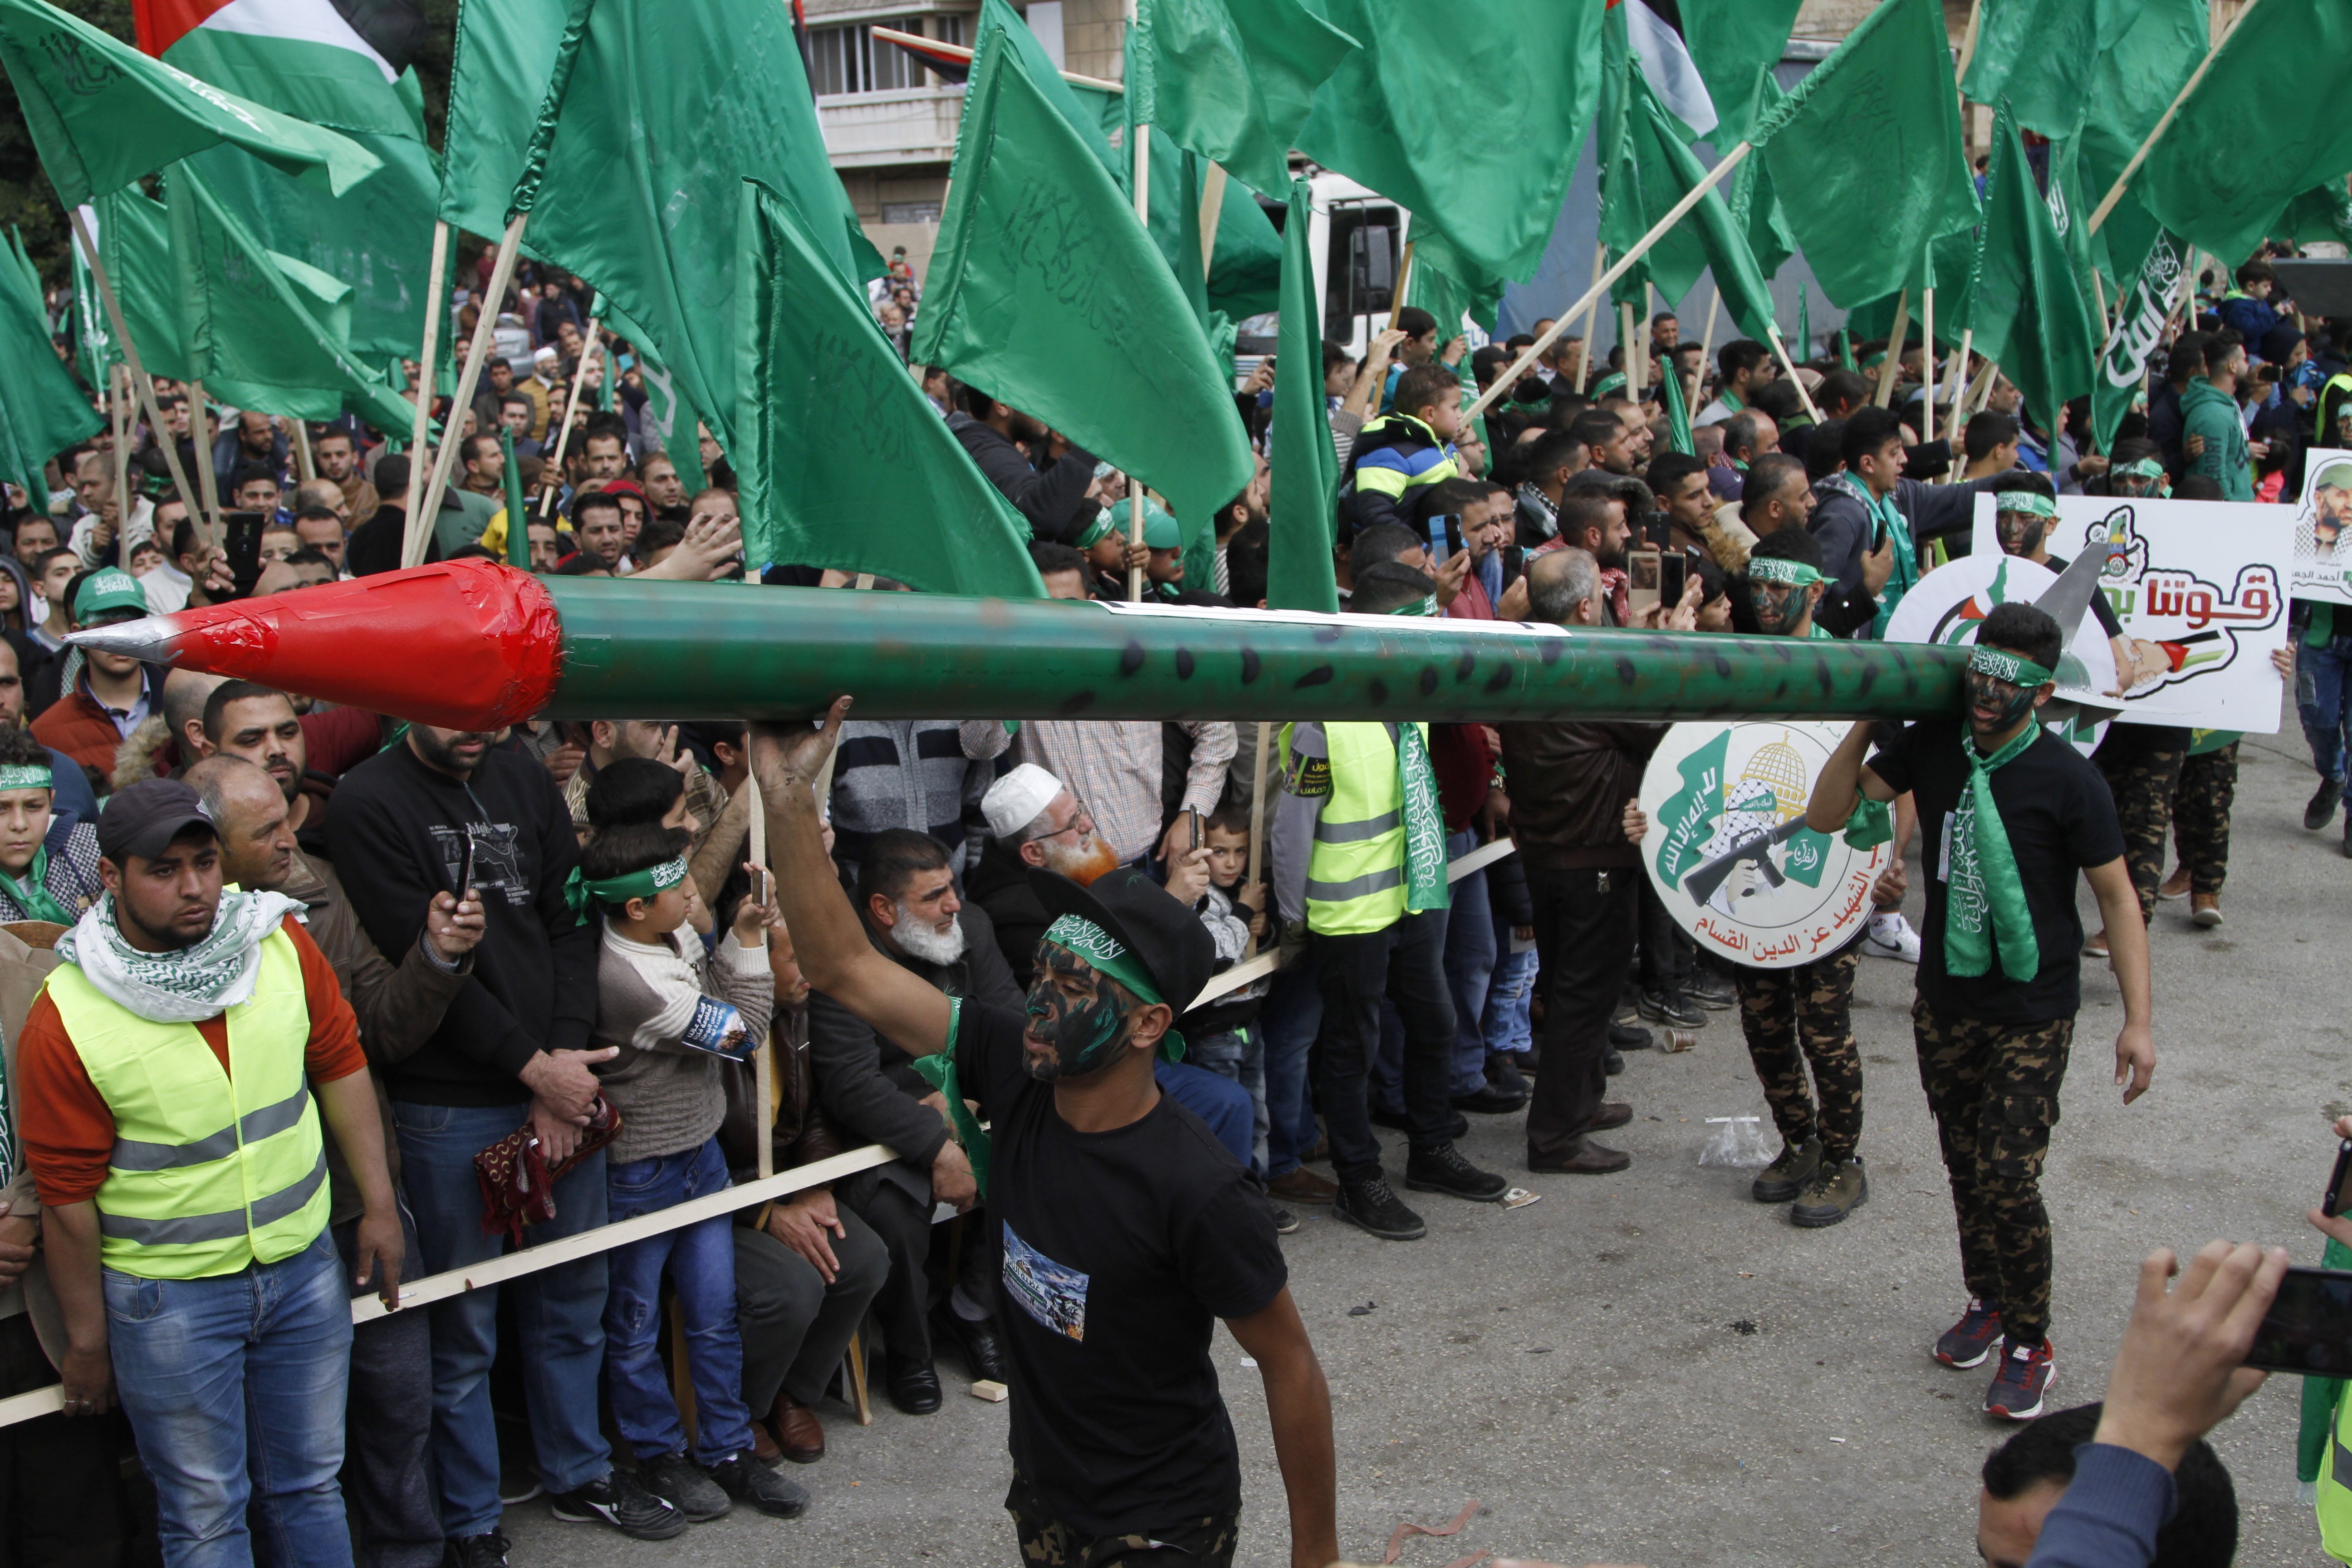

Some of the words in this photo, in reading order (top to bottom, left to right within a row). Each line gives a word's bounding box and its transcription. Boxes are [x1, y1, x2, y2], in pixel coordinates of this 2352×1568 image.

[2146, 574, 2272, 630] قوتنا
[1702, 767, 1716, 796] لا
[1689, 790, 1710, 826] إله
[1665, 838, 1684, 876] الله
[1793, 839, 1818, 871] القرآن
[1833, 870, 1871, 930] الشهيد
[1694, 917, 1749, 952] القسام
[1753, 934, 1801, 962] الدين
[1804, 926, 1831, 954] عز
